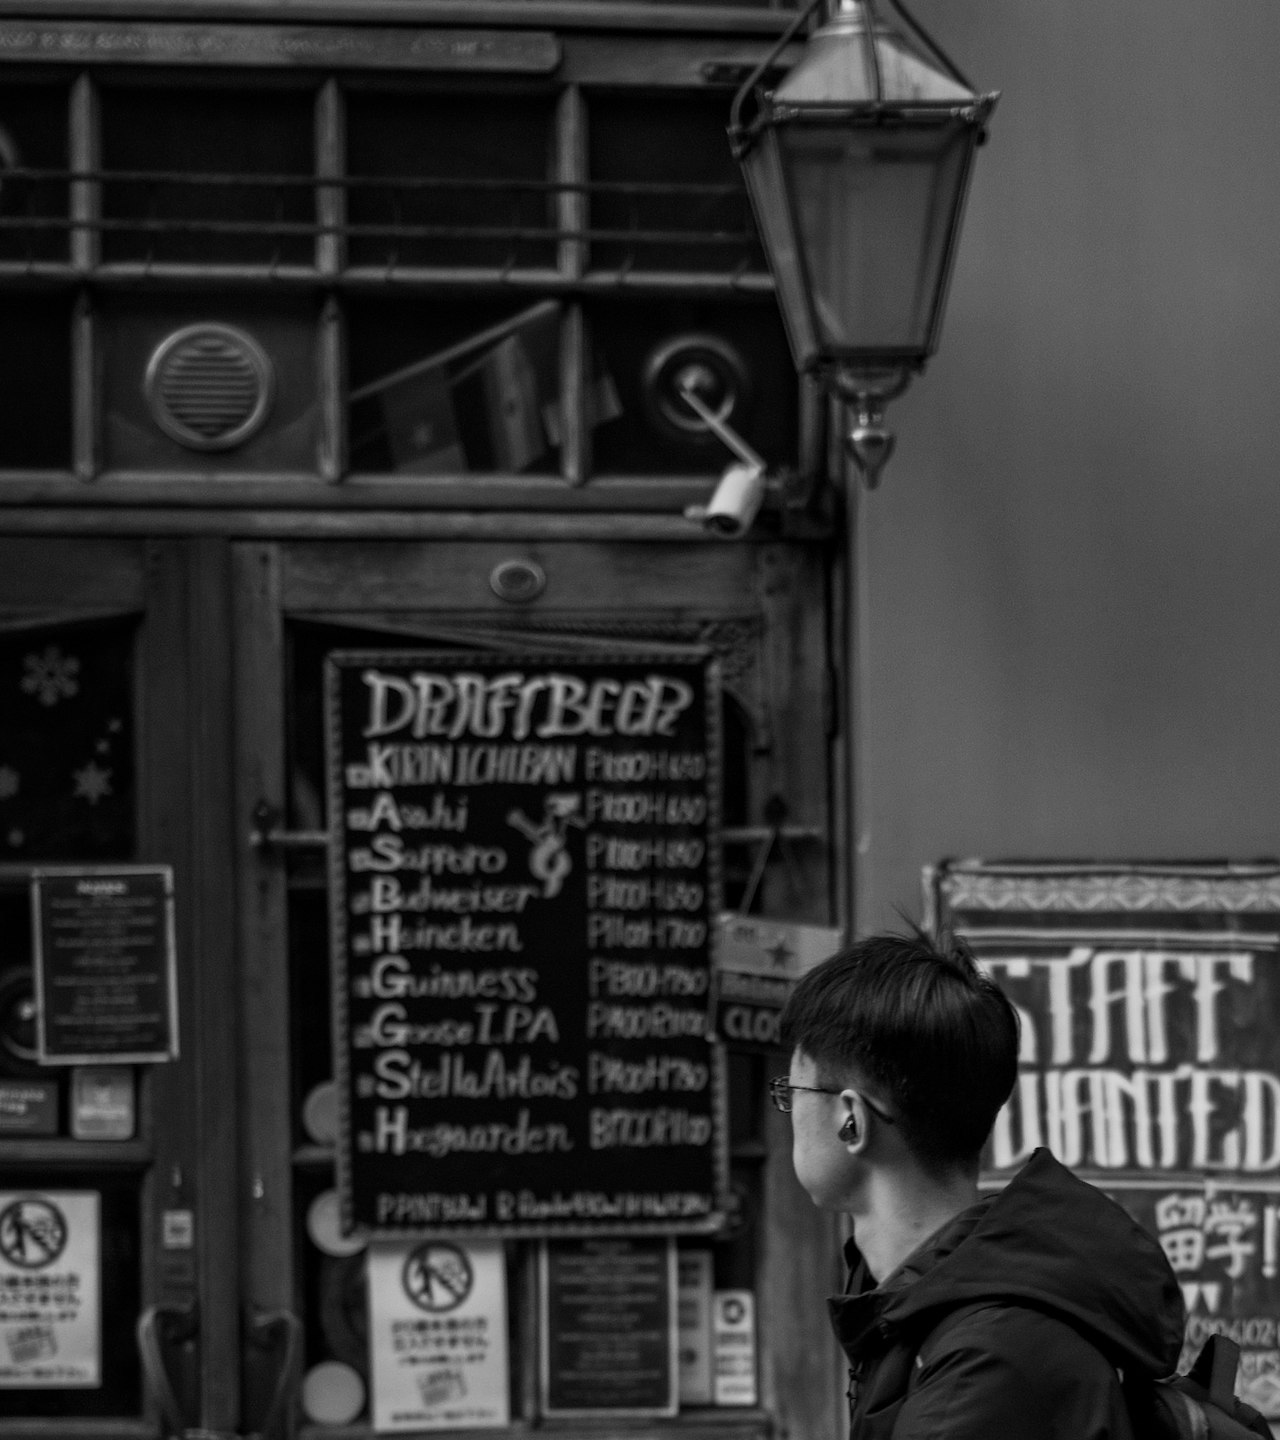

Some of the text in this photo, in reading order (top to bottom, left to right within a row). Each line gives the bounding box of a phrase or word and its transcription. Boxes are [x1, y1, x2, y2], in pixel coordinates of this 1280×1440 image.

[362, 669, 694, 740] DRAFT BEER
[367, 743, 453, 787] KIRIN
[368, 791, 468, 832] Asahi
[370, 833, 508, 875] Sapporo
[371, 874, 539, 913] Budweiser
[370, 955, 539, 1002] Guinness
